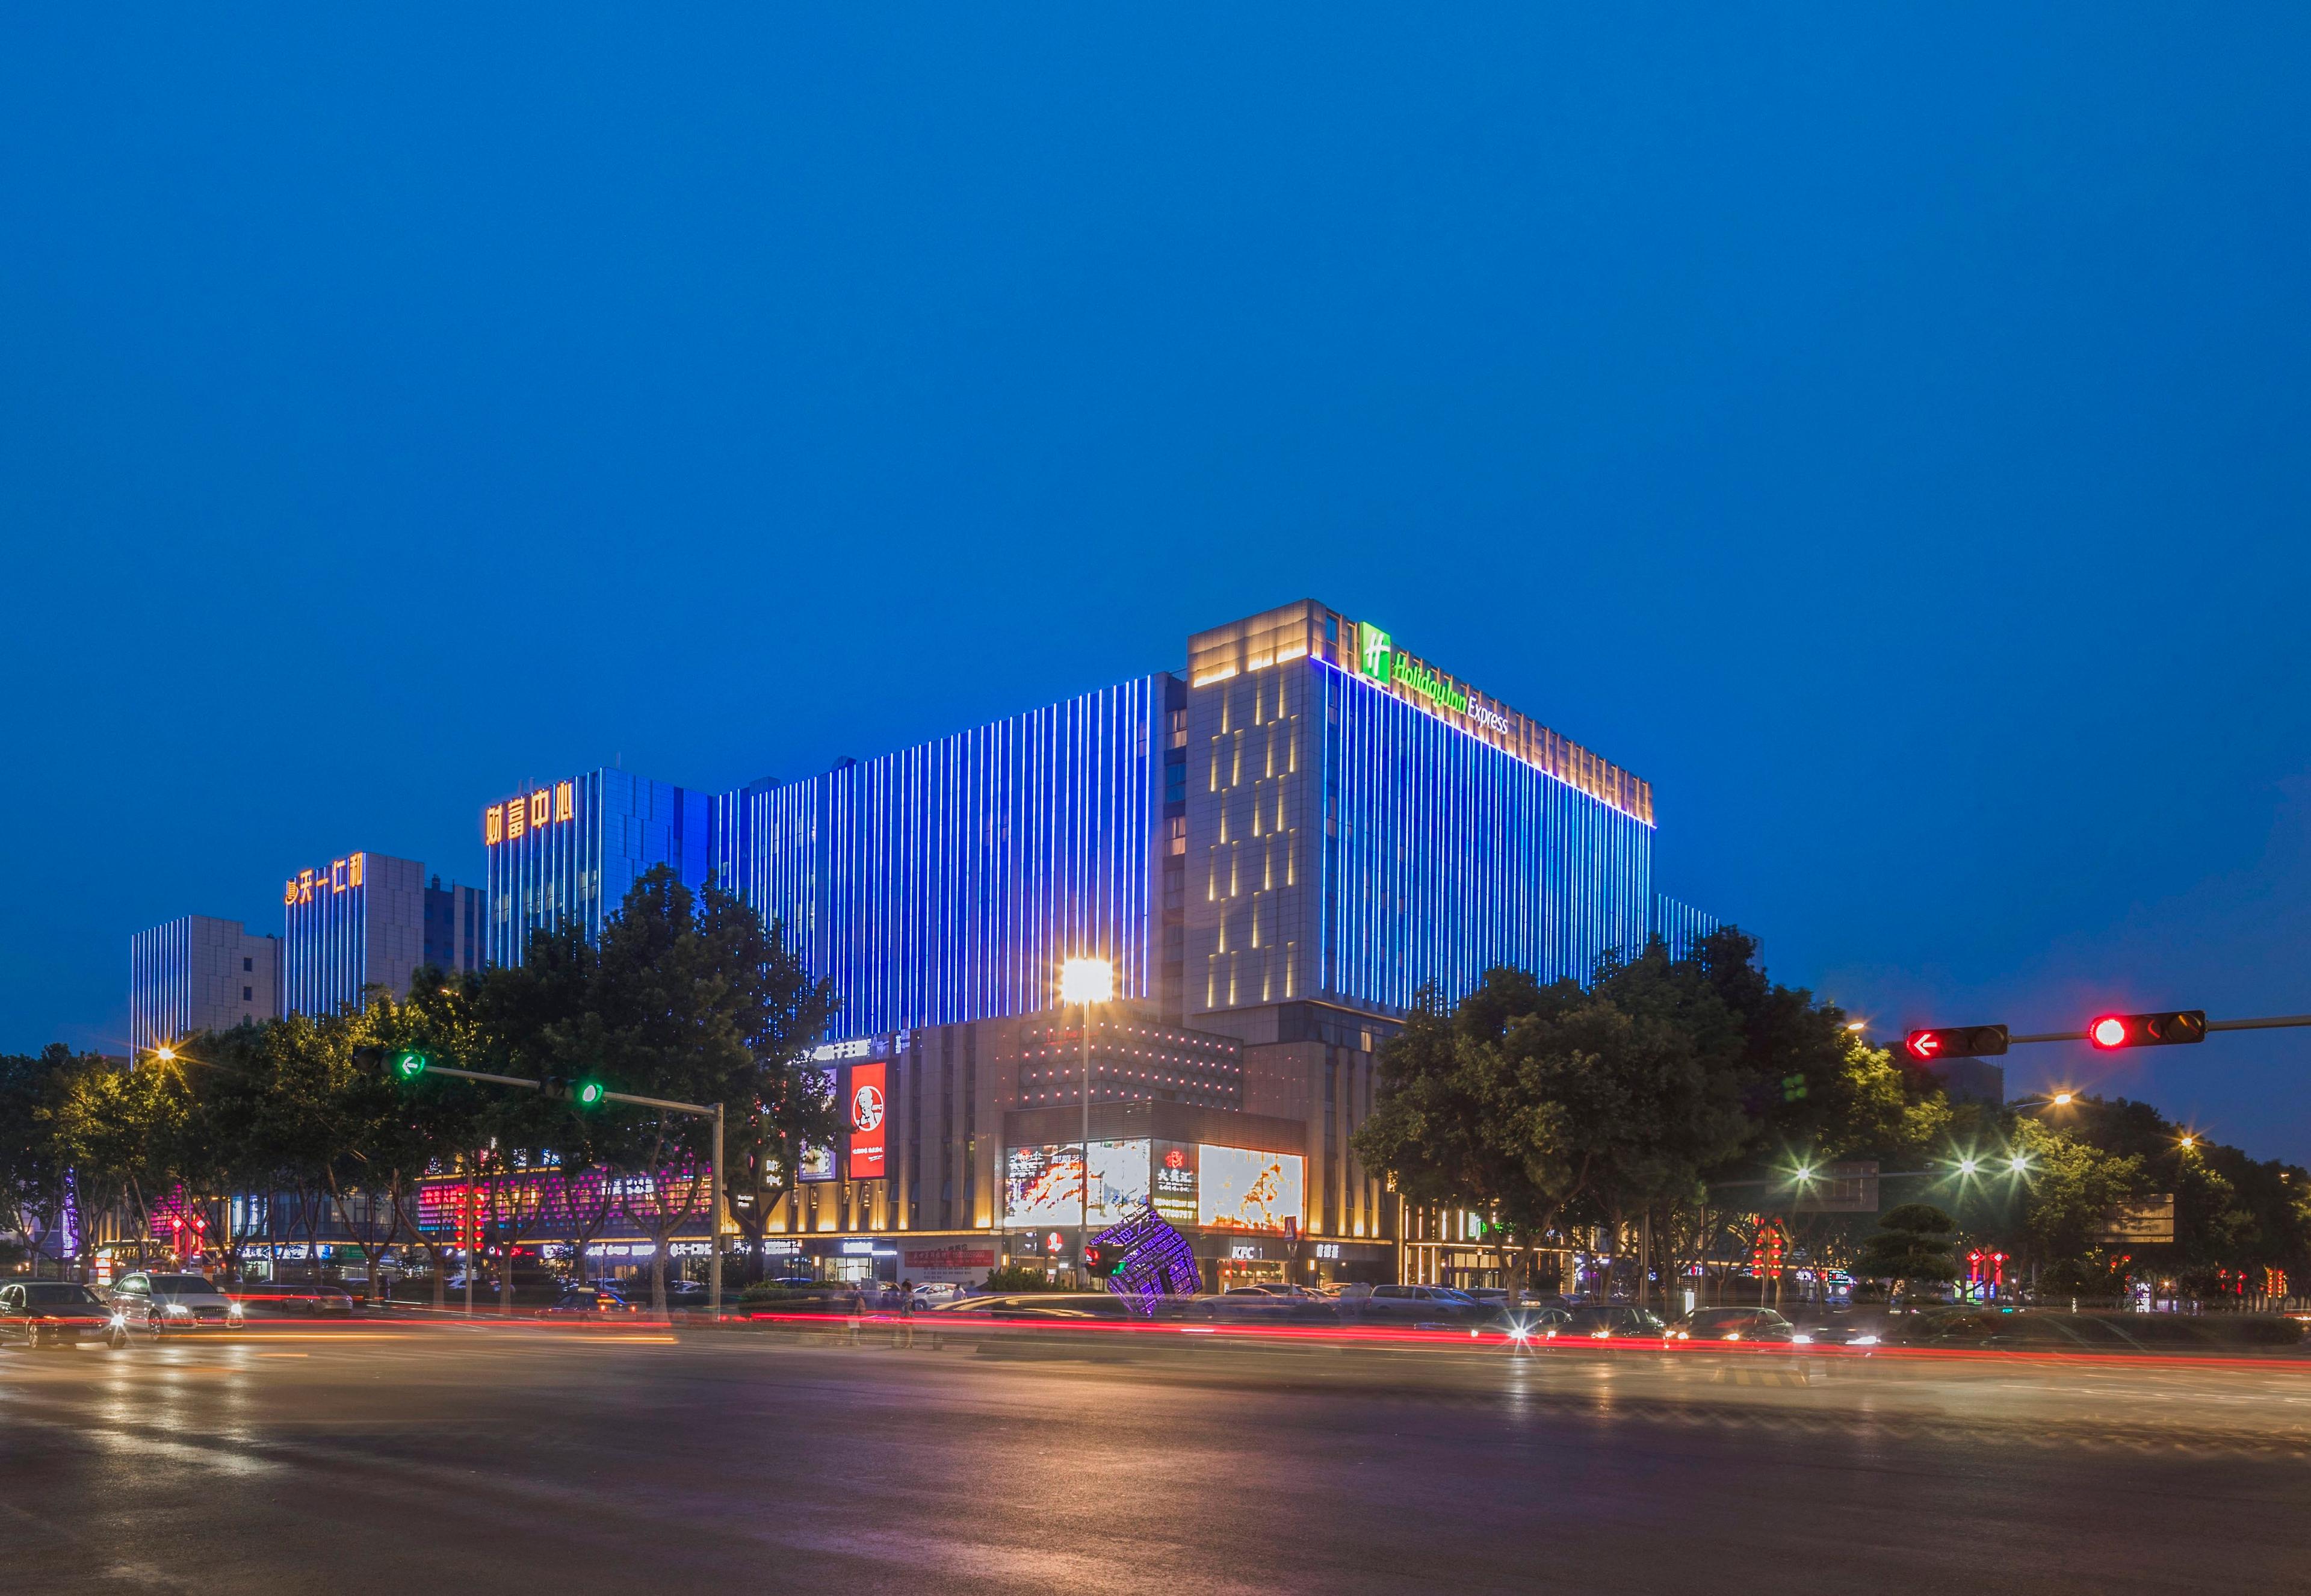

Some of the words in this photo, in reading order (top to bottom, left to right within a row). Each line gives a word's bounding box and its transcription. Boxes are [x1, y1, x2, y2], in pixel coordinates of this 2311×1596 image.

[1393, 652, 1447, 707] Holiday
[1447, 681, 1467, 715] Inn
[1467, 696, 1509, 735] Express
[486, 782, 574, 846] 财富中心
[299, 852, 364, 904] 天一仁和
[1140, 1226, 1174, 1252] FRIENDSHIP
[1232, 1246, 1255, 1260] KFC
